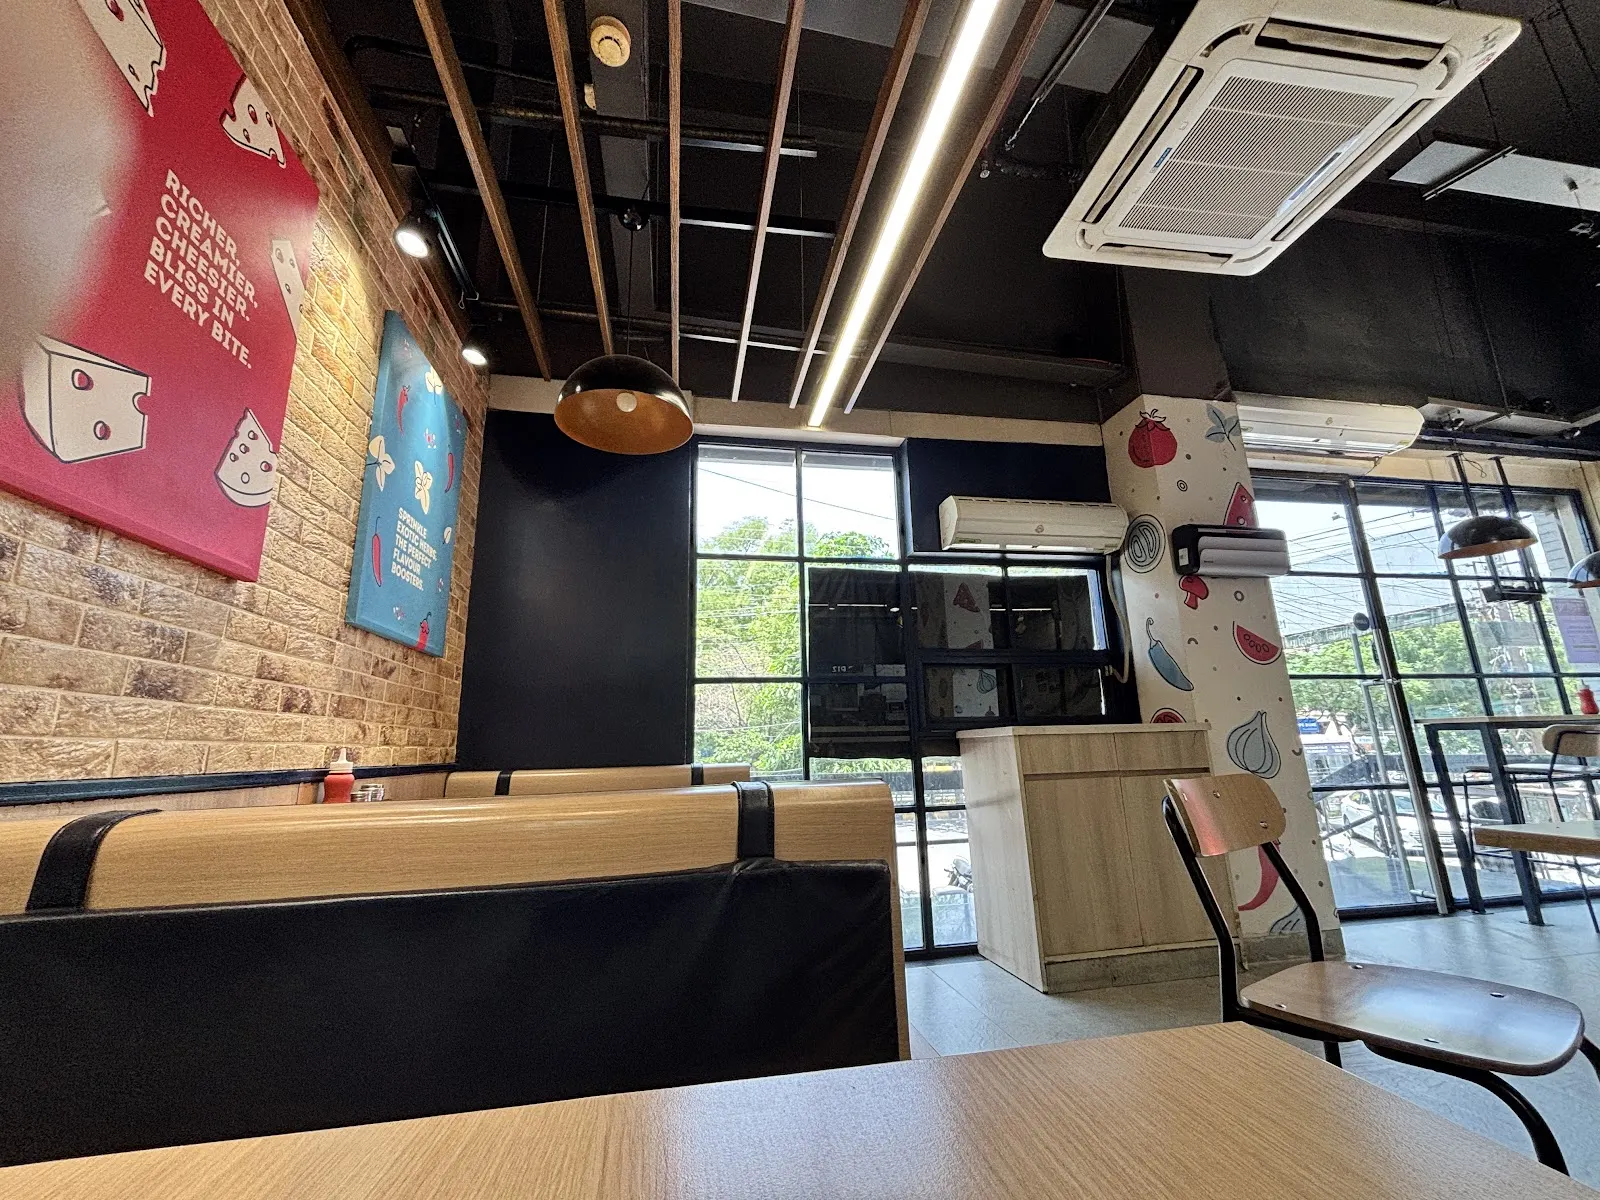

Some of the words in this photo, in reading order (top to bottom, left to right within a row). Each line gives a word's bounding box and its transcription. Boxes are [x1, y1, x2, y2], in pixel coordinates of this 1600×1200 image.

[160, 193, 258, 308] CREAMIER.
[165, 168, 240, 266] RICHER.
[143, 259, 210, 327] EVERY
[211, 319, 252, 369] BITE.
[149, 236, 209, 304] BLISS
[212, 295, 235, 329] IN
[155, 216, 250, 322] CHEESIER.
[392, 547, 421, 575] FLAVOUR
[395, 533, 408, 552] THE
[396, 520, 419, 546] EXOTIC
[398, 507, 427, 539] SPRINKLE
